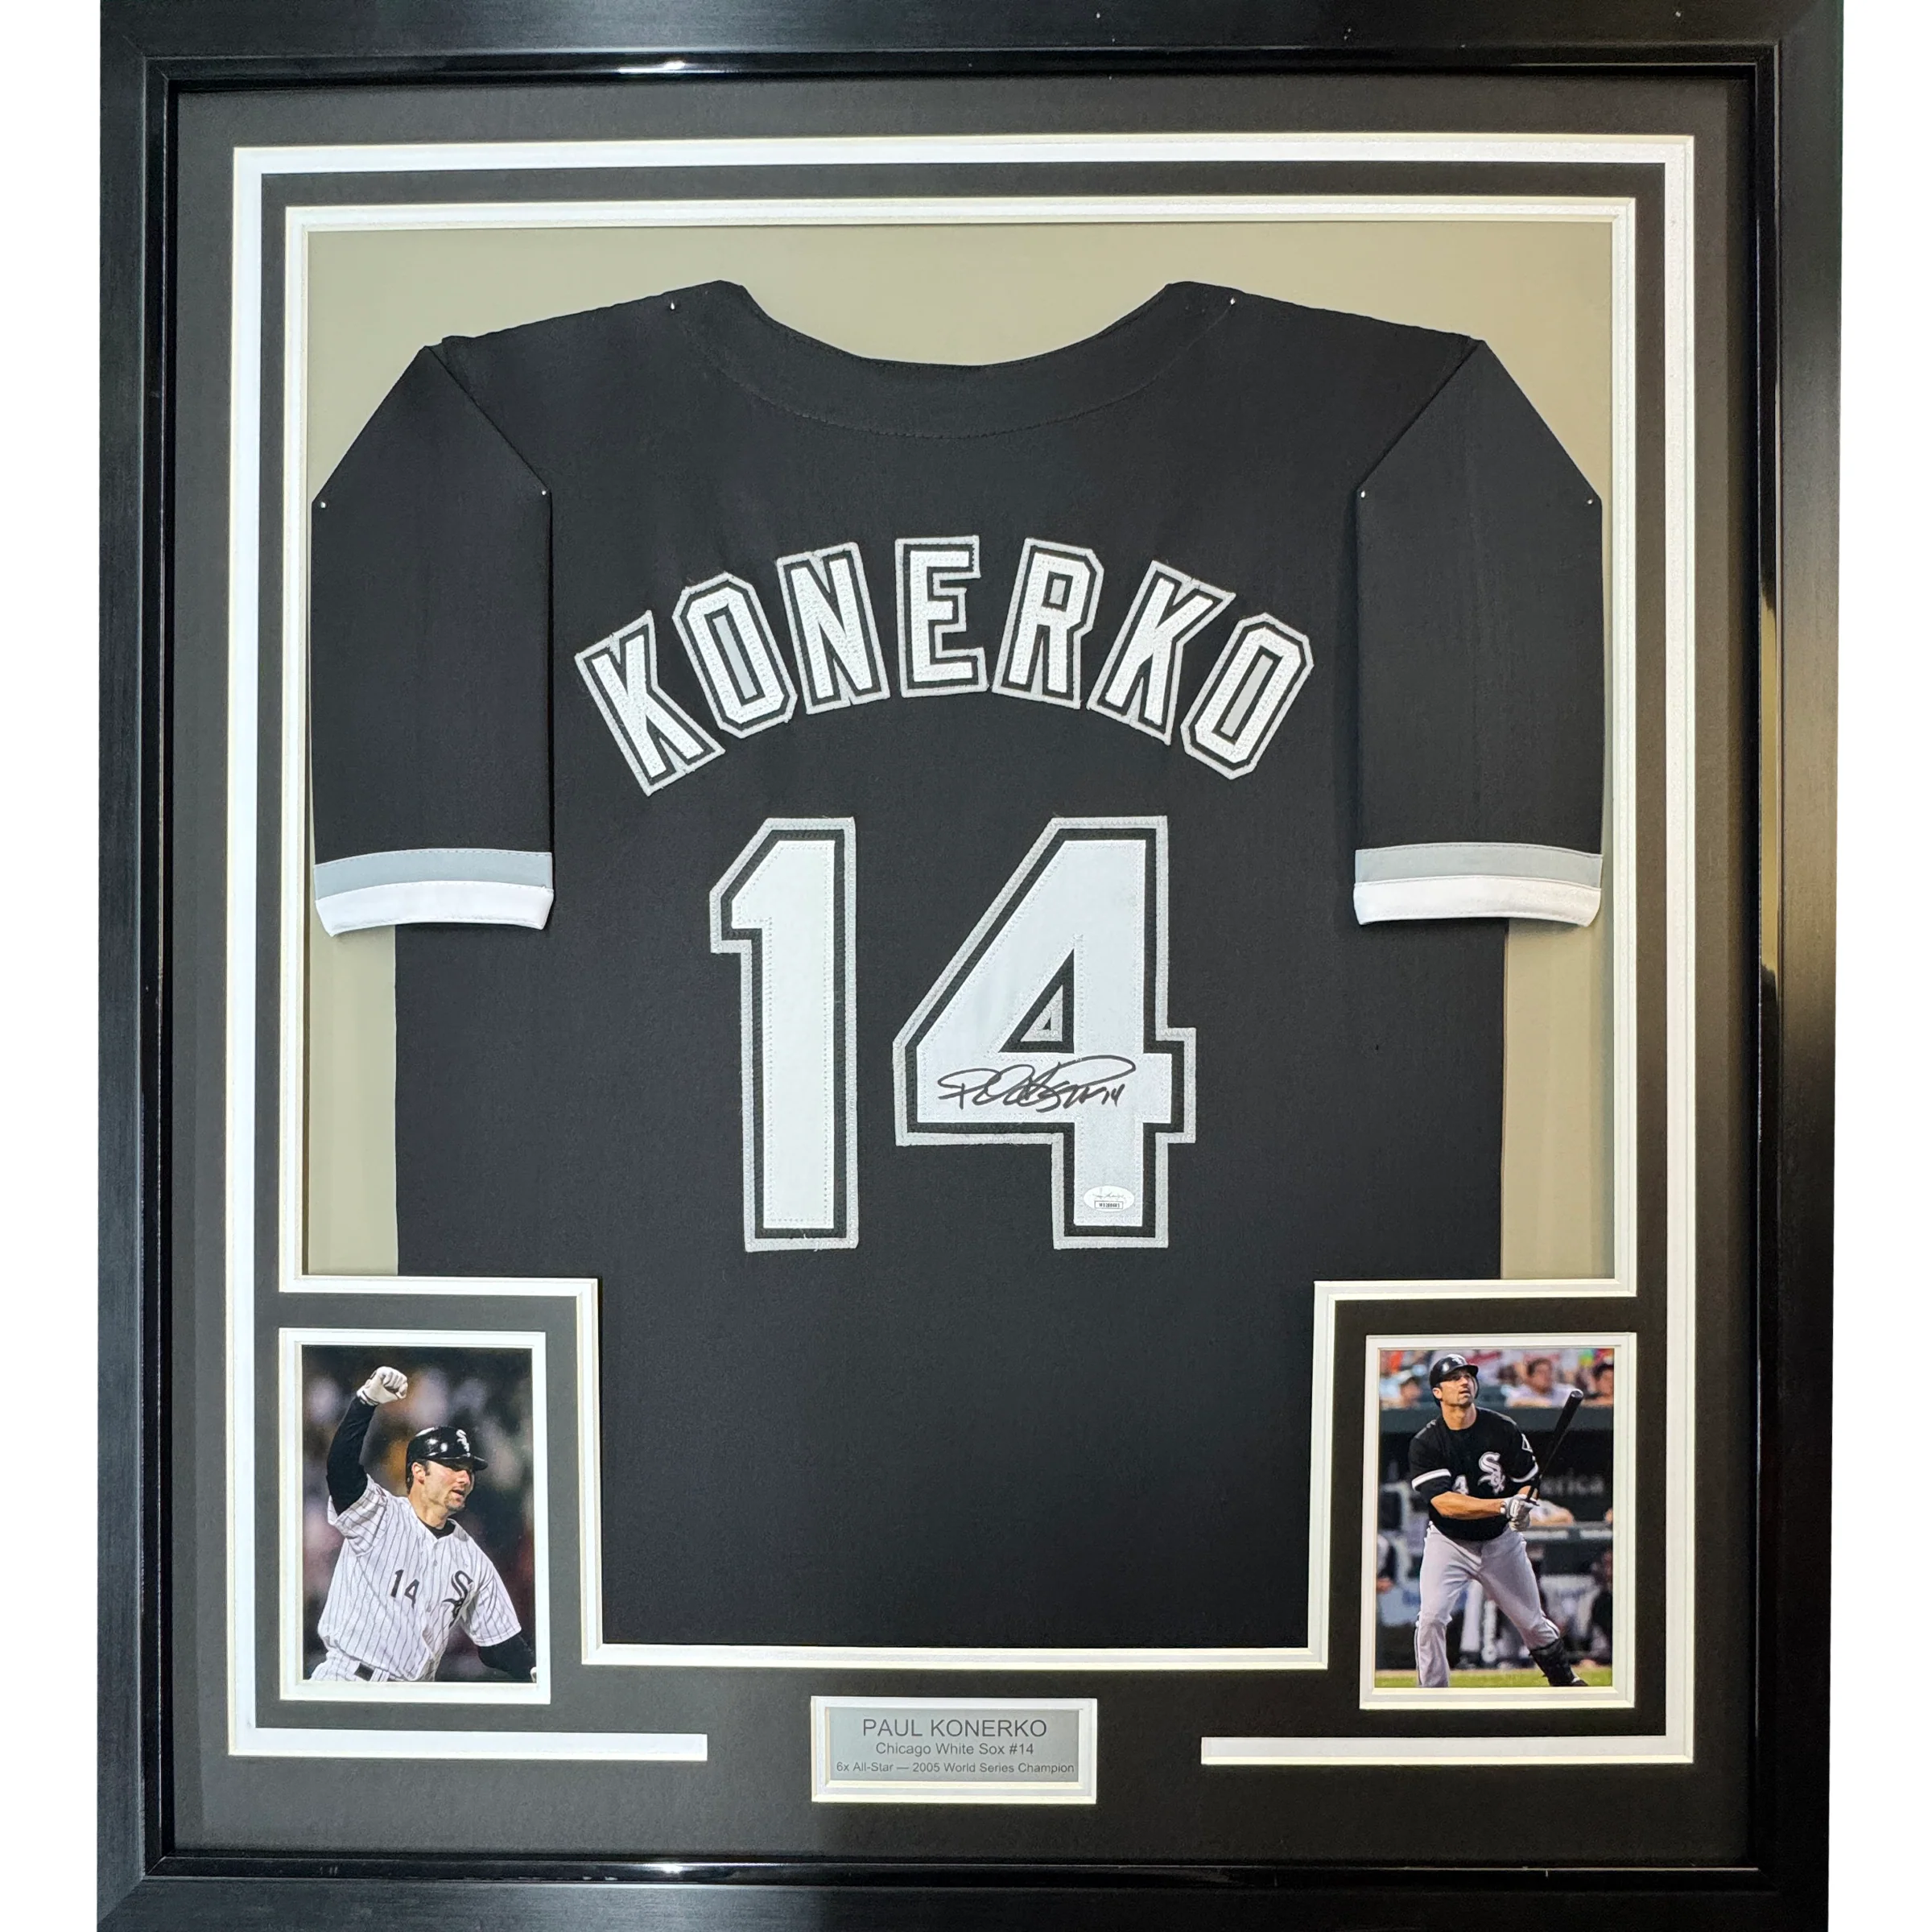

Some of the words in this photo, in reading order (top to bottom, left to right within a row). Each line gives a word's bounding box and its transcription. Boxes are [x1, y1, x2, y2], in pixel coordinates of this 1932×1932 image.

[575, 535, 1314, 795] KONERKO
[709, 815, 1196, 1252] 14
[390, 1569, 419, 1609] 14
[863, 1719, 923, 1736] PAUL
[931, 1719, 1047, 1737] KONERKO
[876, 1742, 931, 1757] Chicago
[935, 1743, 974, 1755] White
[979, 1743, 1005, 1755] Sox
[1009, 1743, 1034, 1755] #14
[836, 1761, 850, 1772] 6x
[852, 1761, 893, 1772] All-Star
[912, 1762, 940, 1773] 2005
[943, 1762, 976, 1773] World
[979, 1762, 1014, 1773] Series
[1018, 1763, 1075, 1775] Champion
